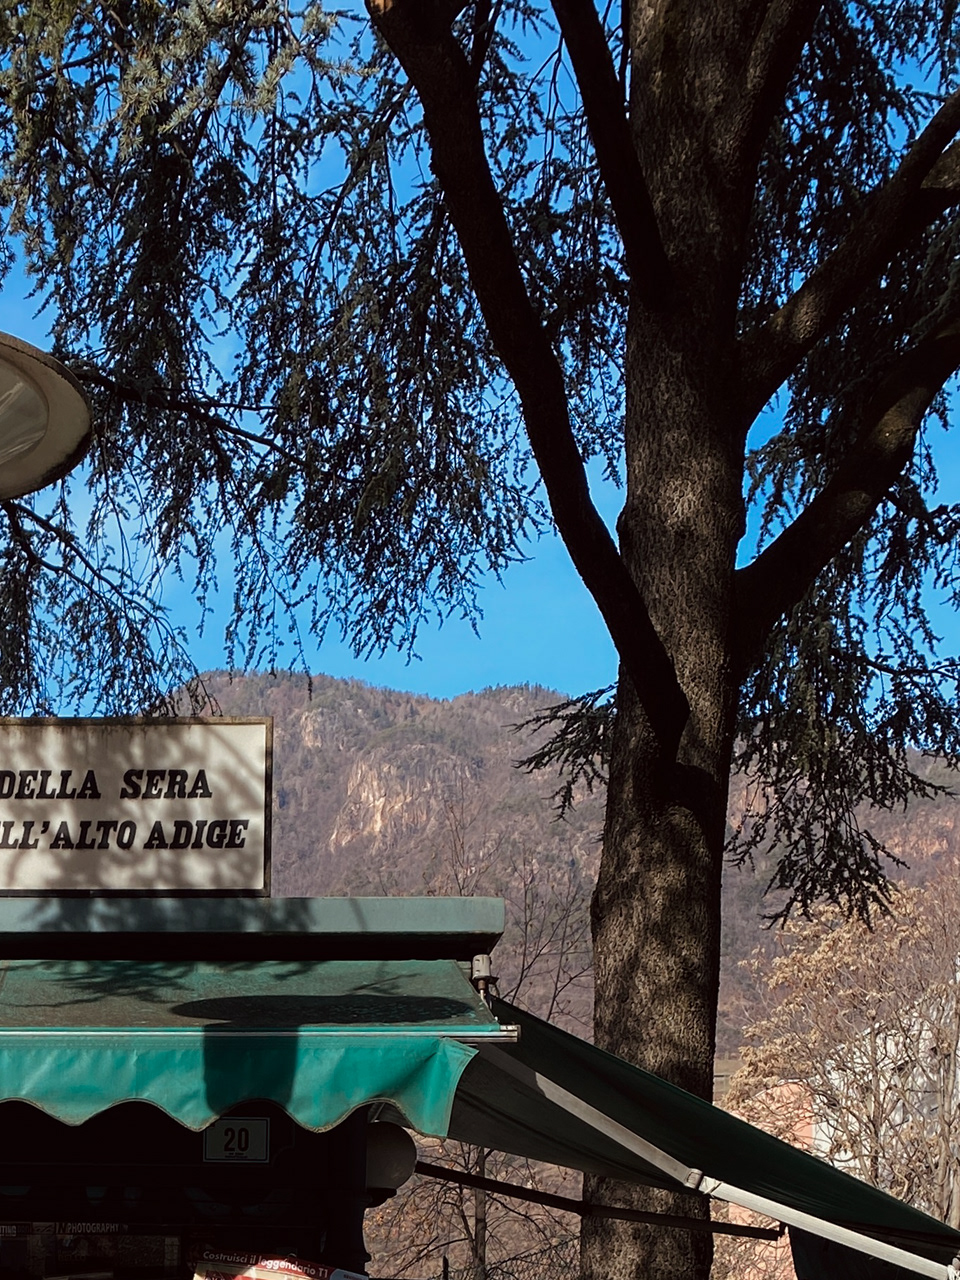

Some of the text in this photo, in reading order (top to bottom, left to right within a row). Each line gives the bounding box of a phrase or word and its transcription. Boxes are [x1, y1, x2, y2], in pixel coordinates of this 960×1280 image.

[120, 769, 214, 799] SERA
[144, 819, 250, 850] ADIGE
[224, 1127, 249, 1152] 20
[67, 1222, 120, 1234] PHOTOGRAPHY
[202, 1250, 329, 1279] Costruisci il leggendario T1
